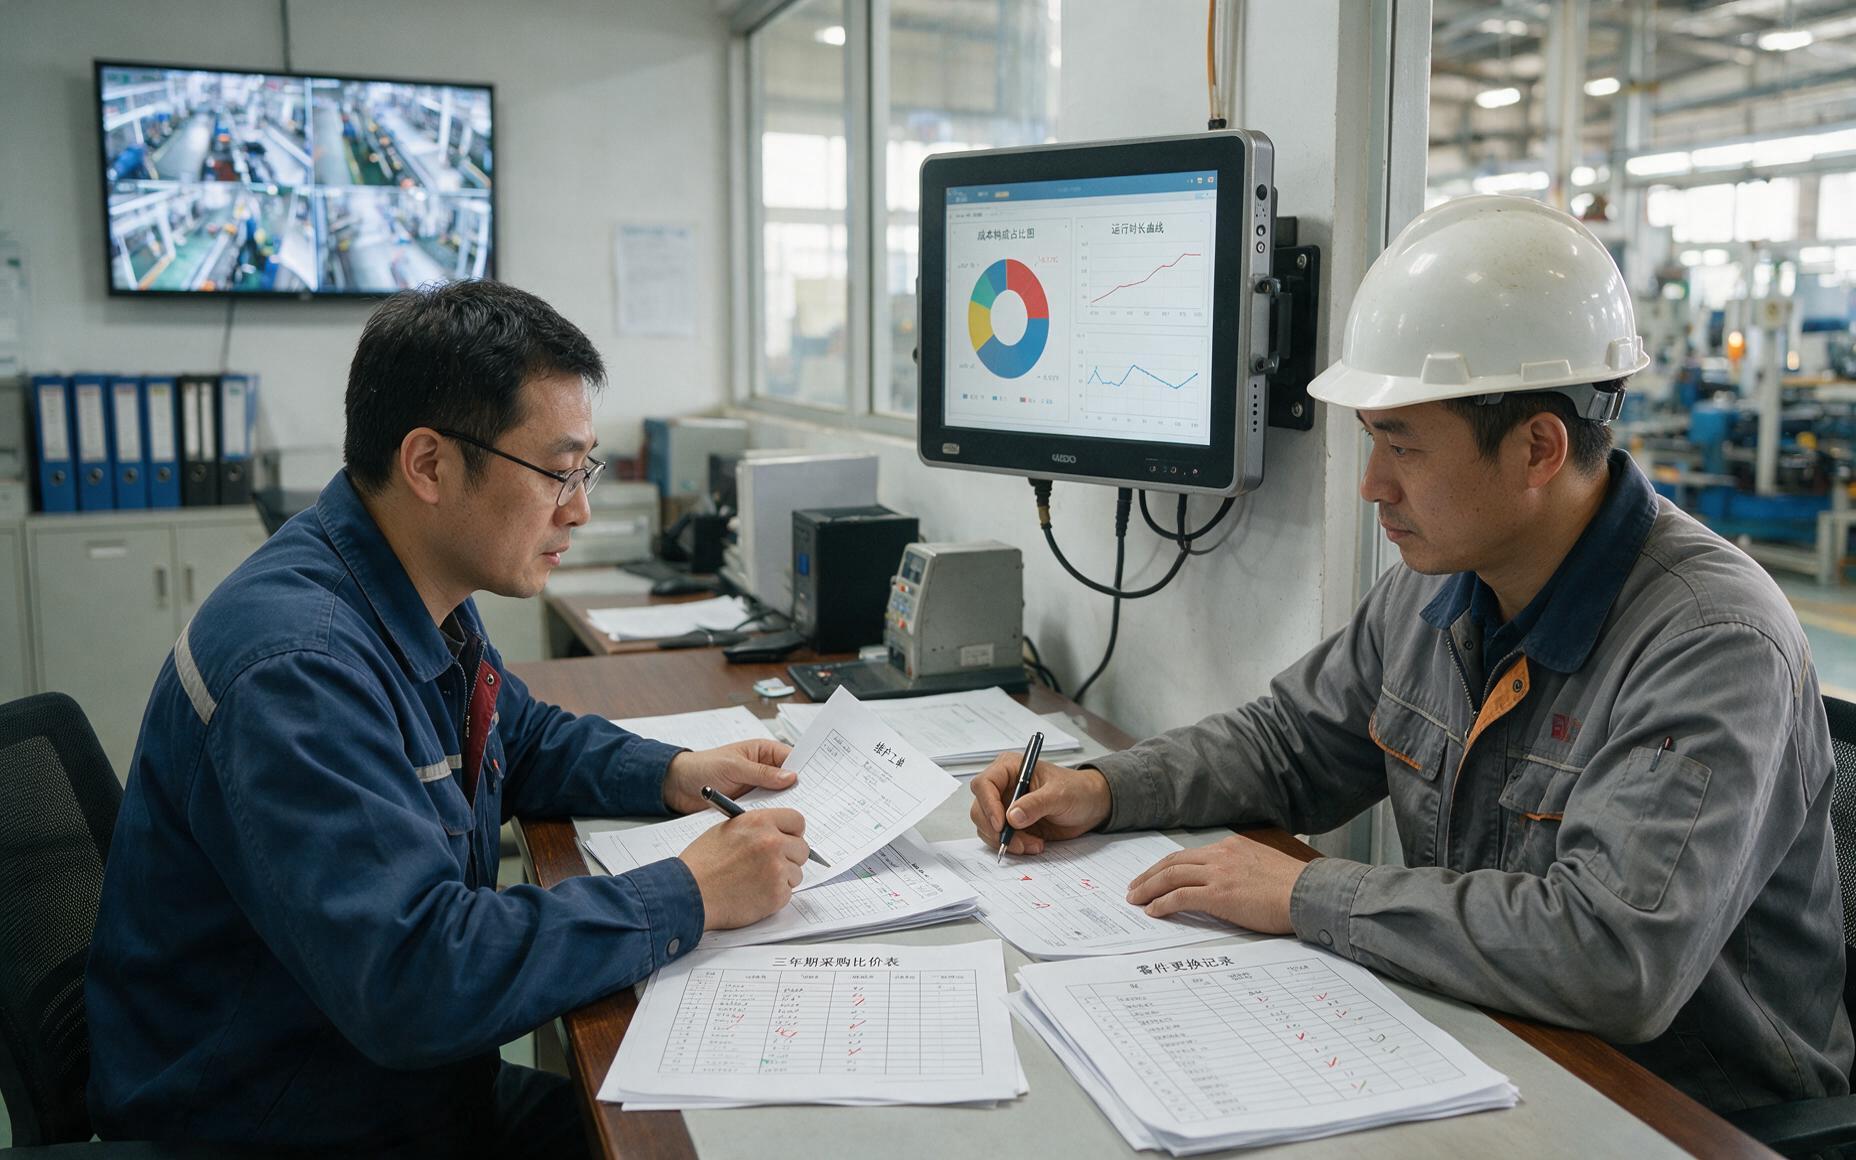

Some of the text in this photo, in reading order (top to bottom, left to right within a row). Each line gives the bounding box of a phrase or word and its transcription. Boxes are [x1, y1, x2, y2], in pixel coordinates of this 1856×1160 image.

[772, 956, 901, 968] 三年期采购比价表
